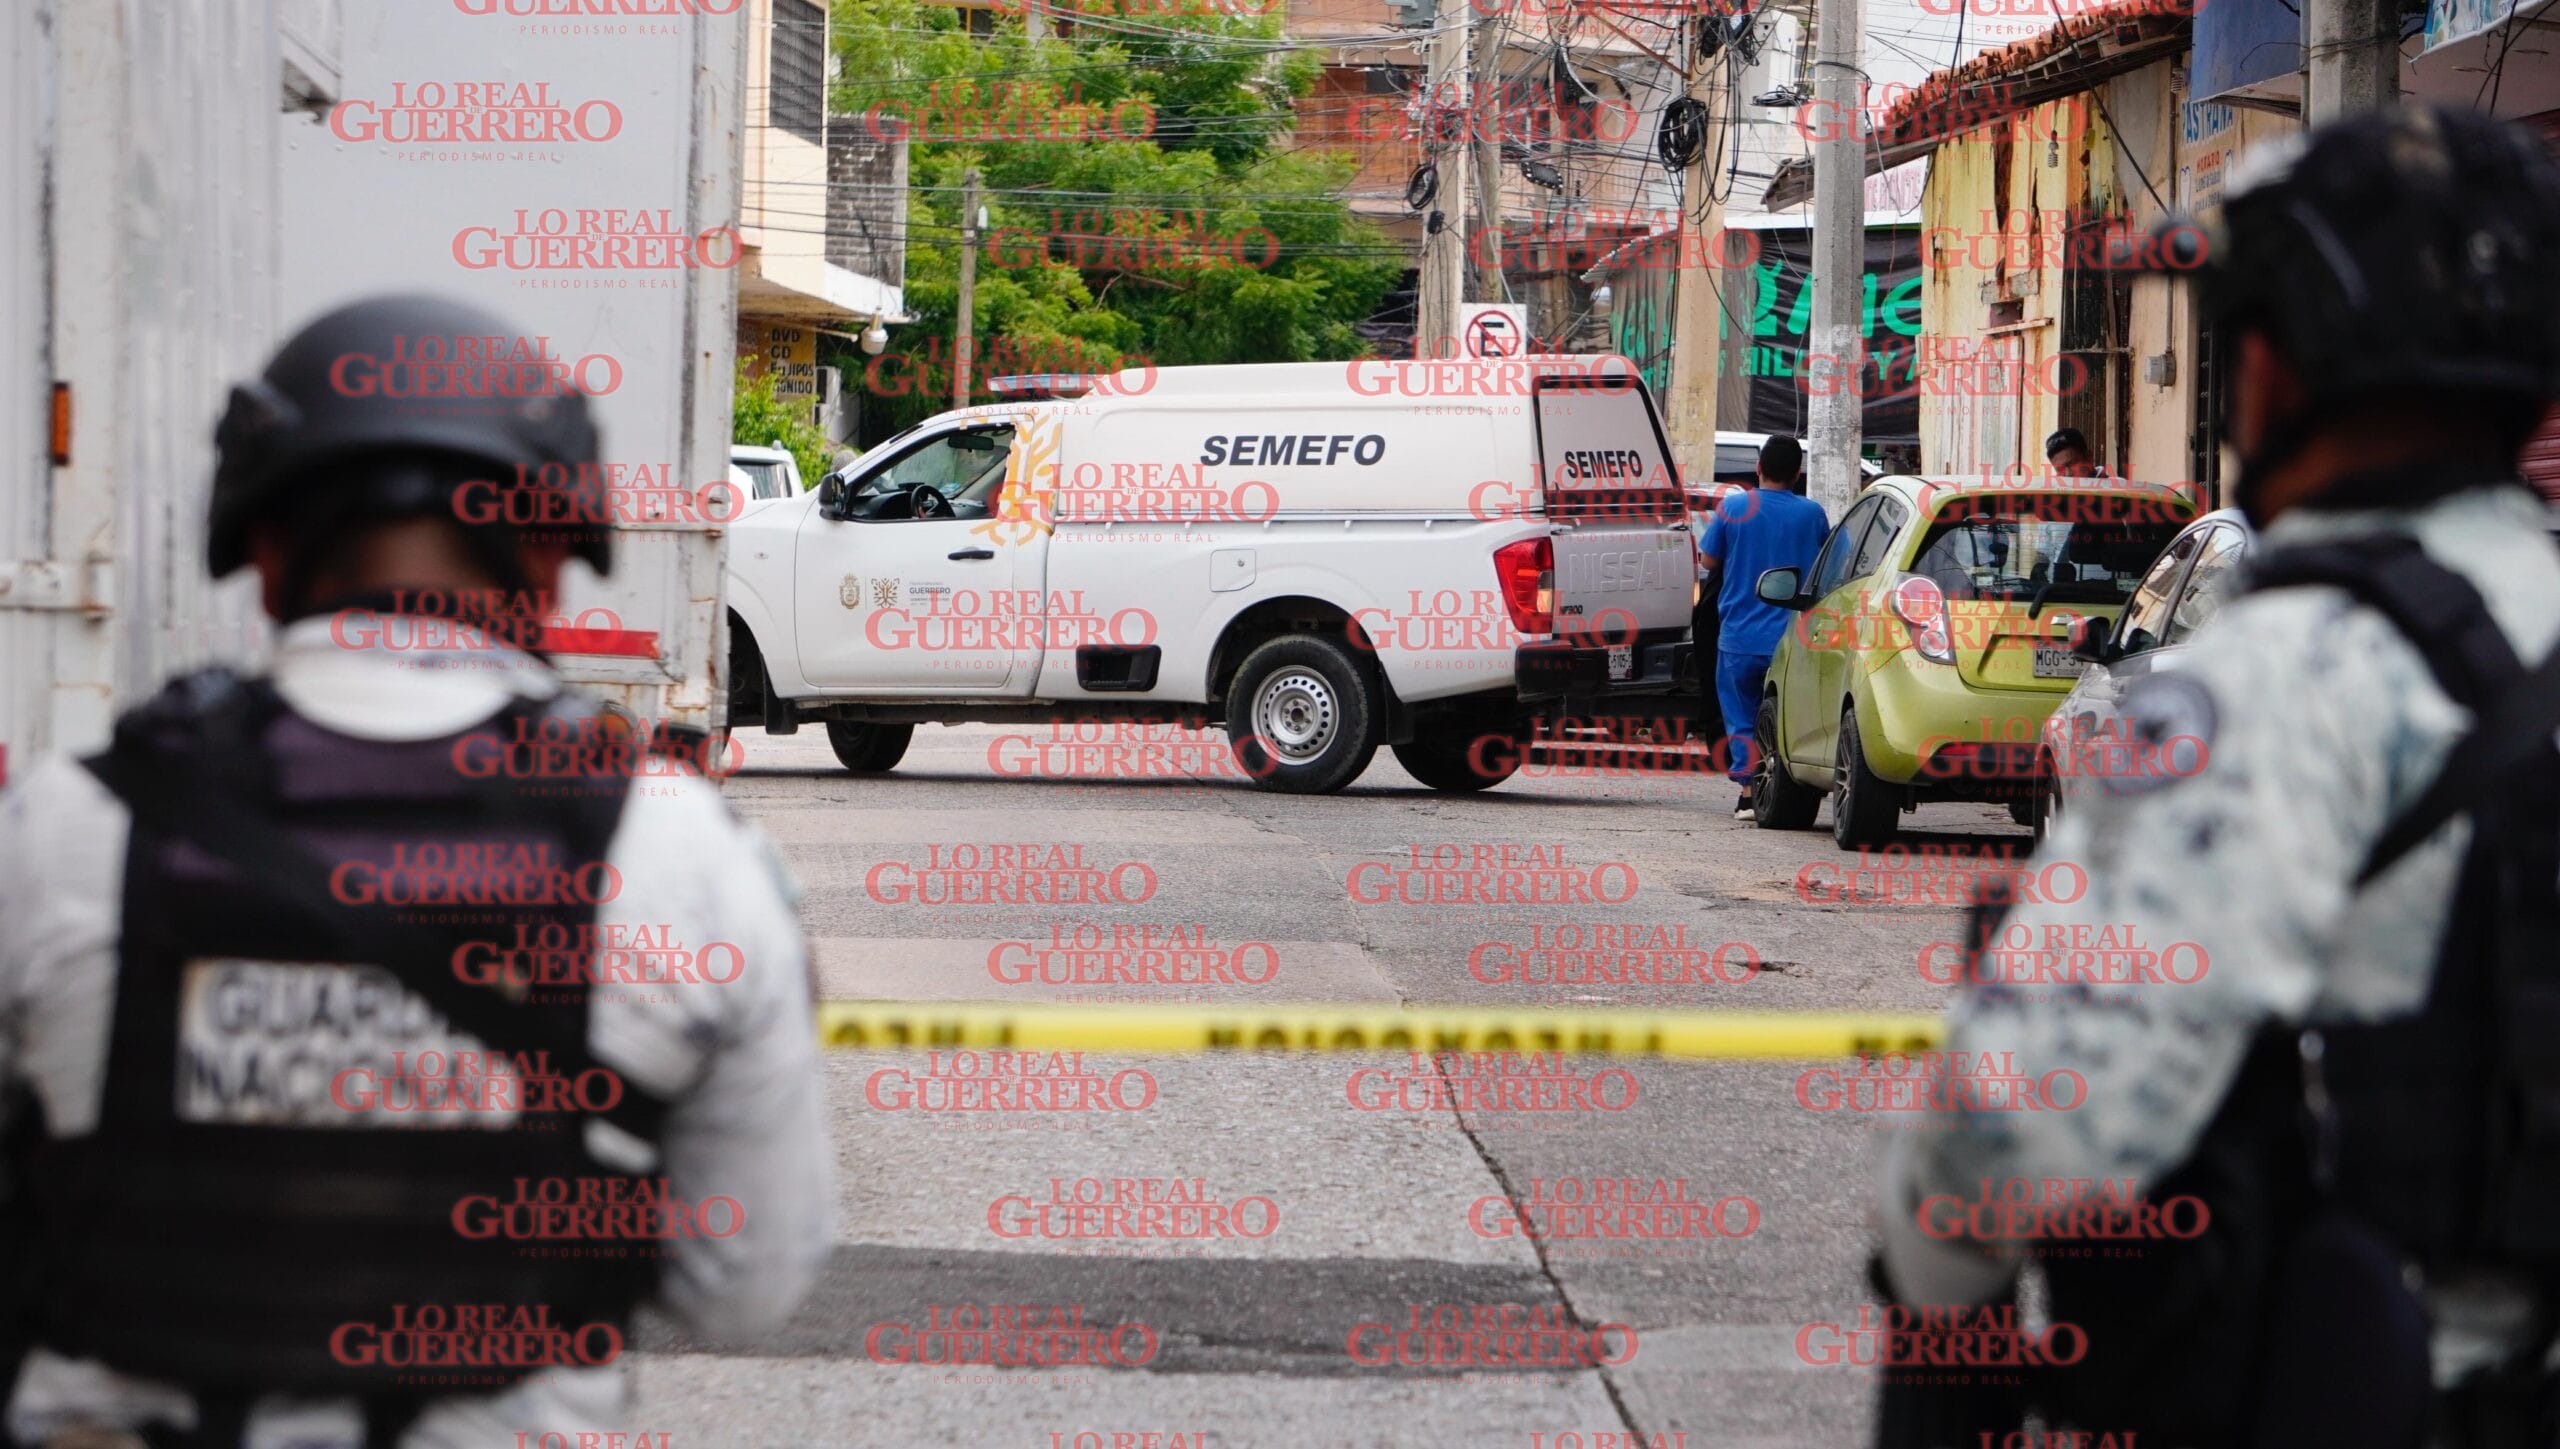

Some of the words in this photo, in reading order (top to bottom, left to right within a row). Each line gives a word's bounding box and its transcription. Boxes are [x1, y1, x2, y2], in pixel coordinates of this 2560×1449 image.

[772, 329, 800, 342] DVD
[771, 346, 791, 359] CD
[1200, 434, 1386, 467] SEMEFO
[1565, 450, 1643, 478] SEMEFO
